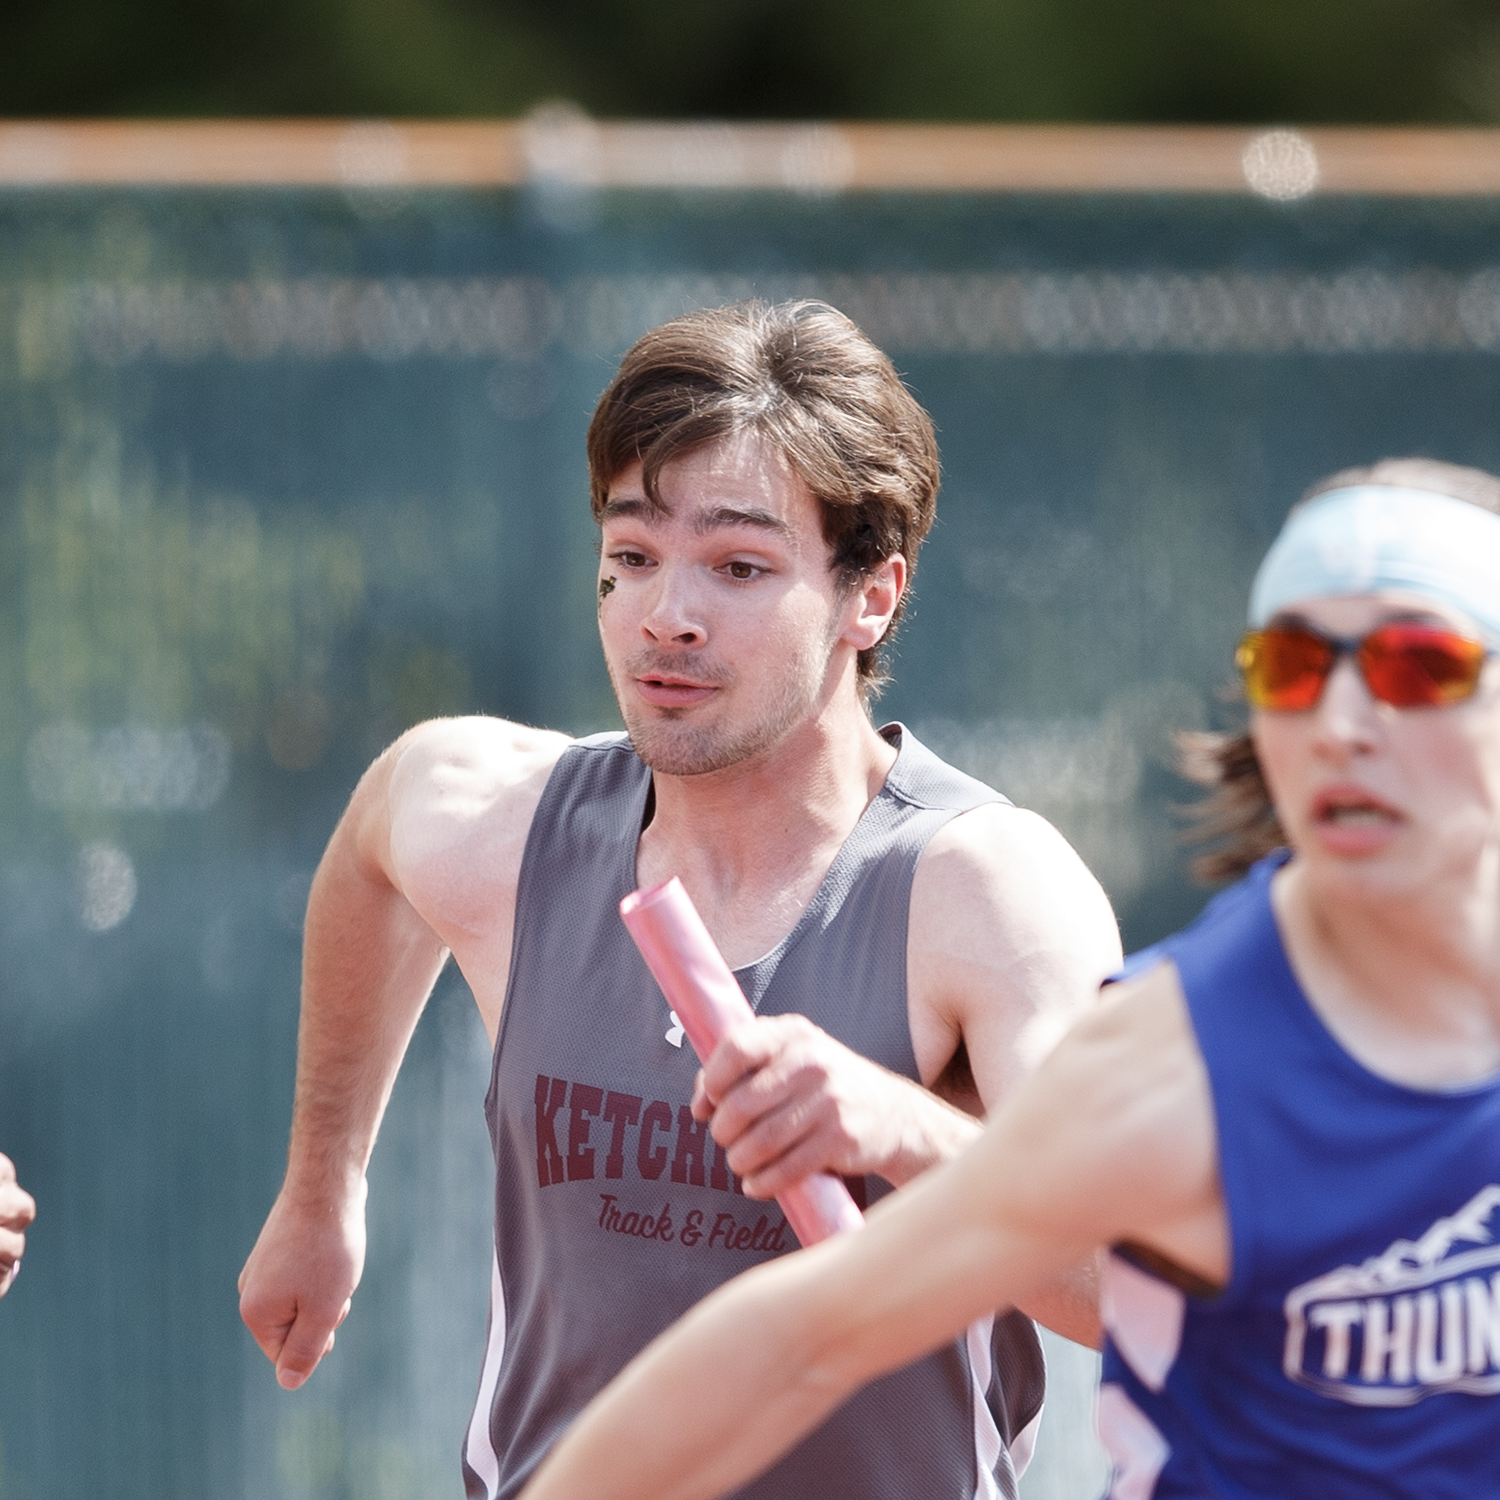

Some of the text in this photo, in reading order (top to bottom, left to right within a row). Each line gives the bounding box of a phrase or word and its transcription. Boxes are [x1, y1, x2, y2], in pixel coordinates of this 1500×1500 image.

[599, 1193, 787, 1251] Track & Field
